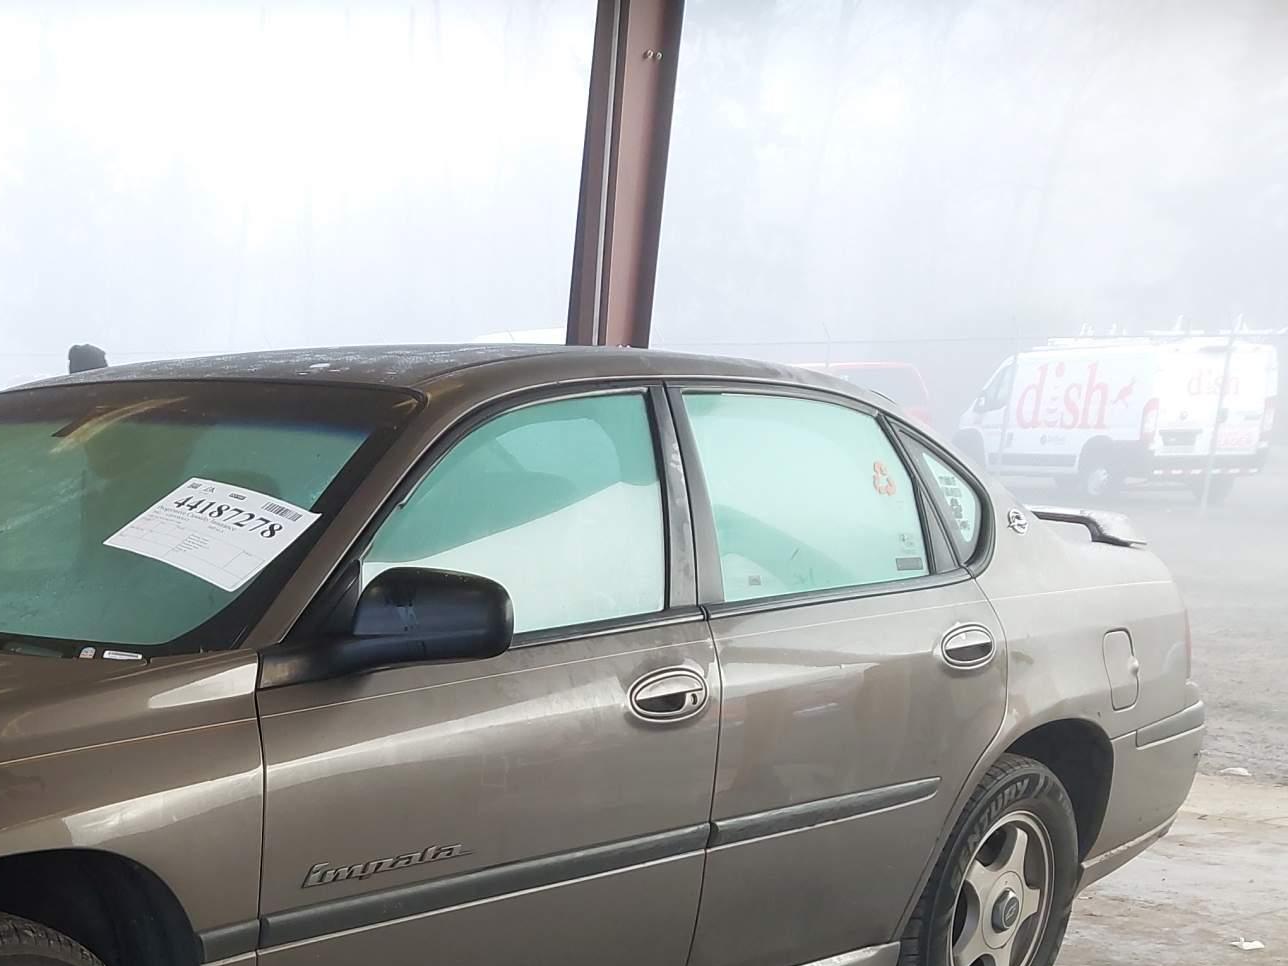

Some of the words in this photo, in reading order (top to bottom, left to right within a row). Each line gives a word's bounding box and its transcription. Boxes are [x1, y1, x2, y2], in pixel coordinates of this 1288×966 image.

[1016, 361, 1109, 430] dish
[174, 496, 283, 538] 44187278
[301, 844, 473, 889] Impala
